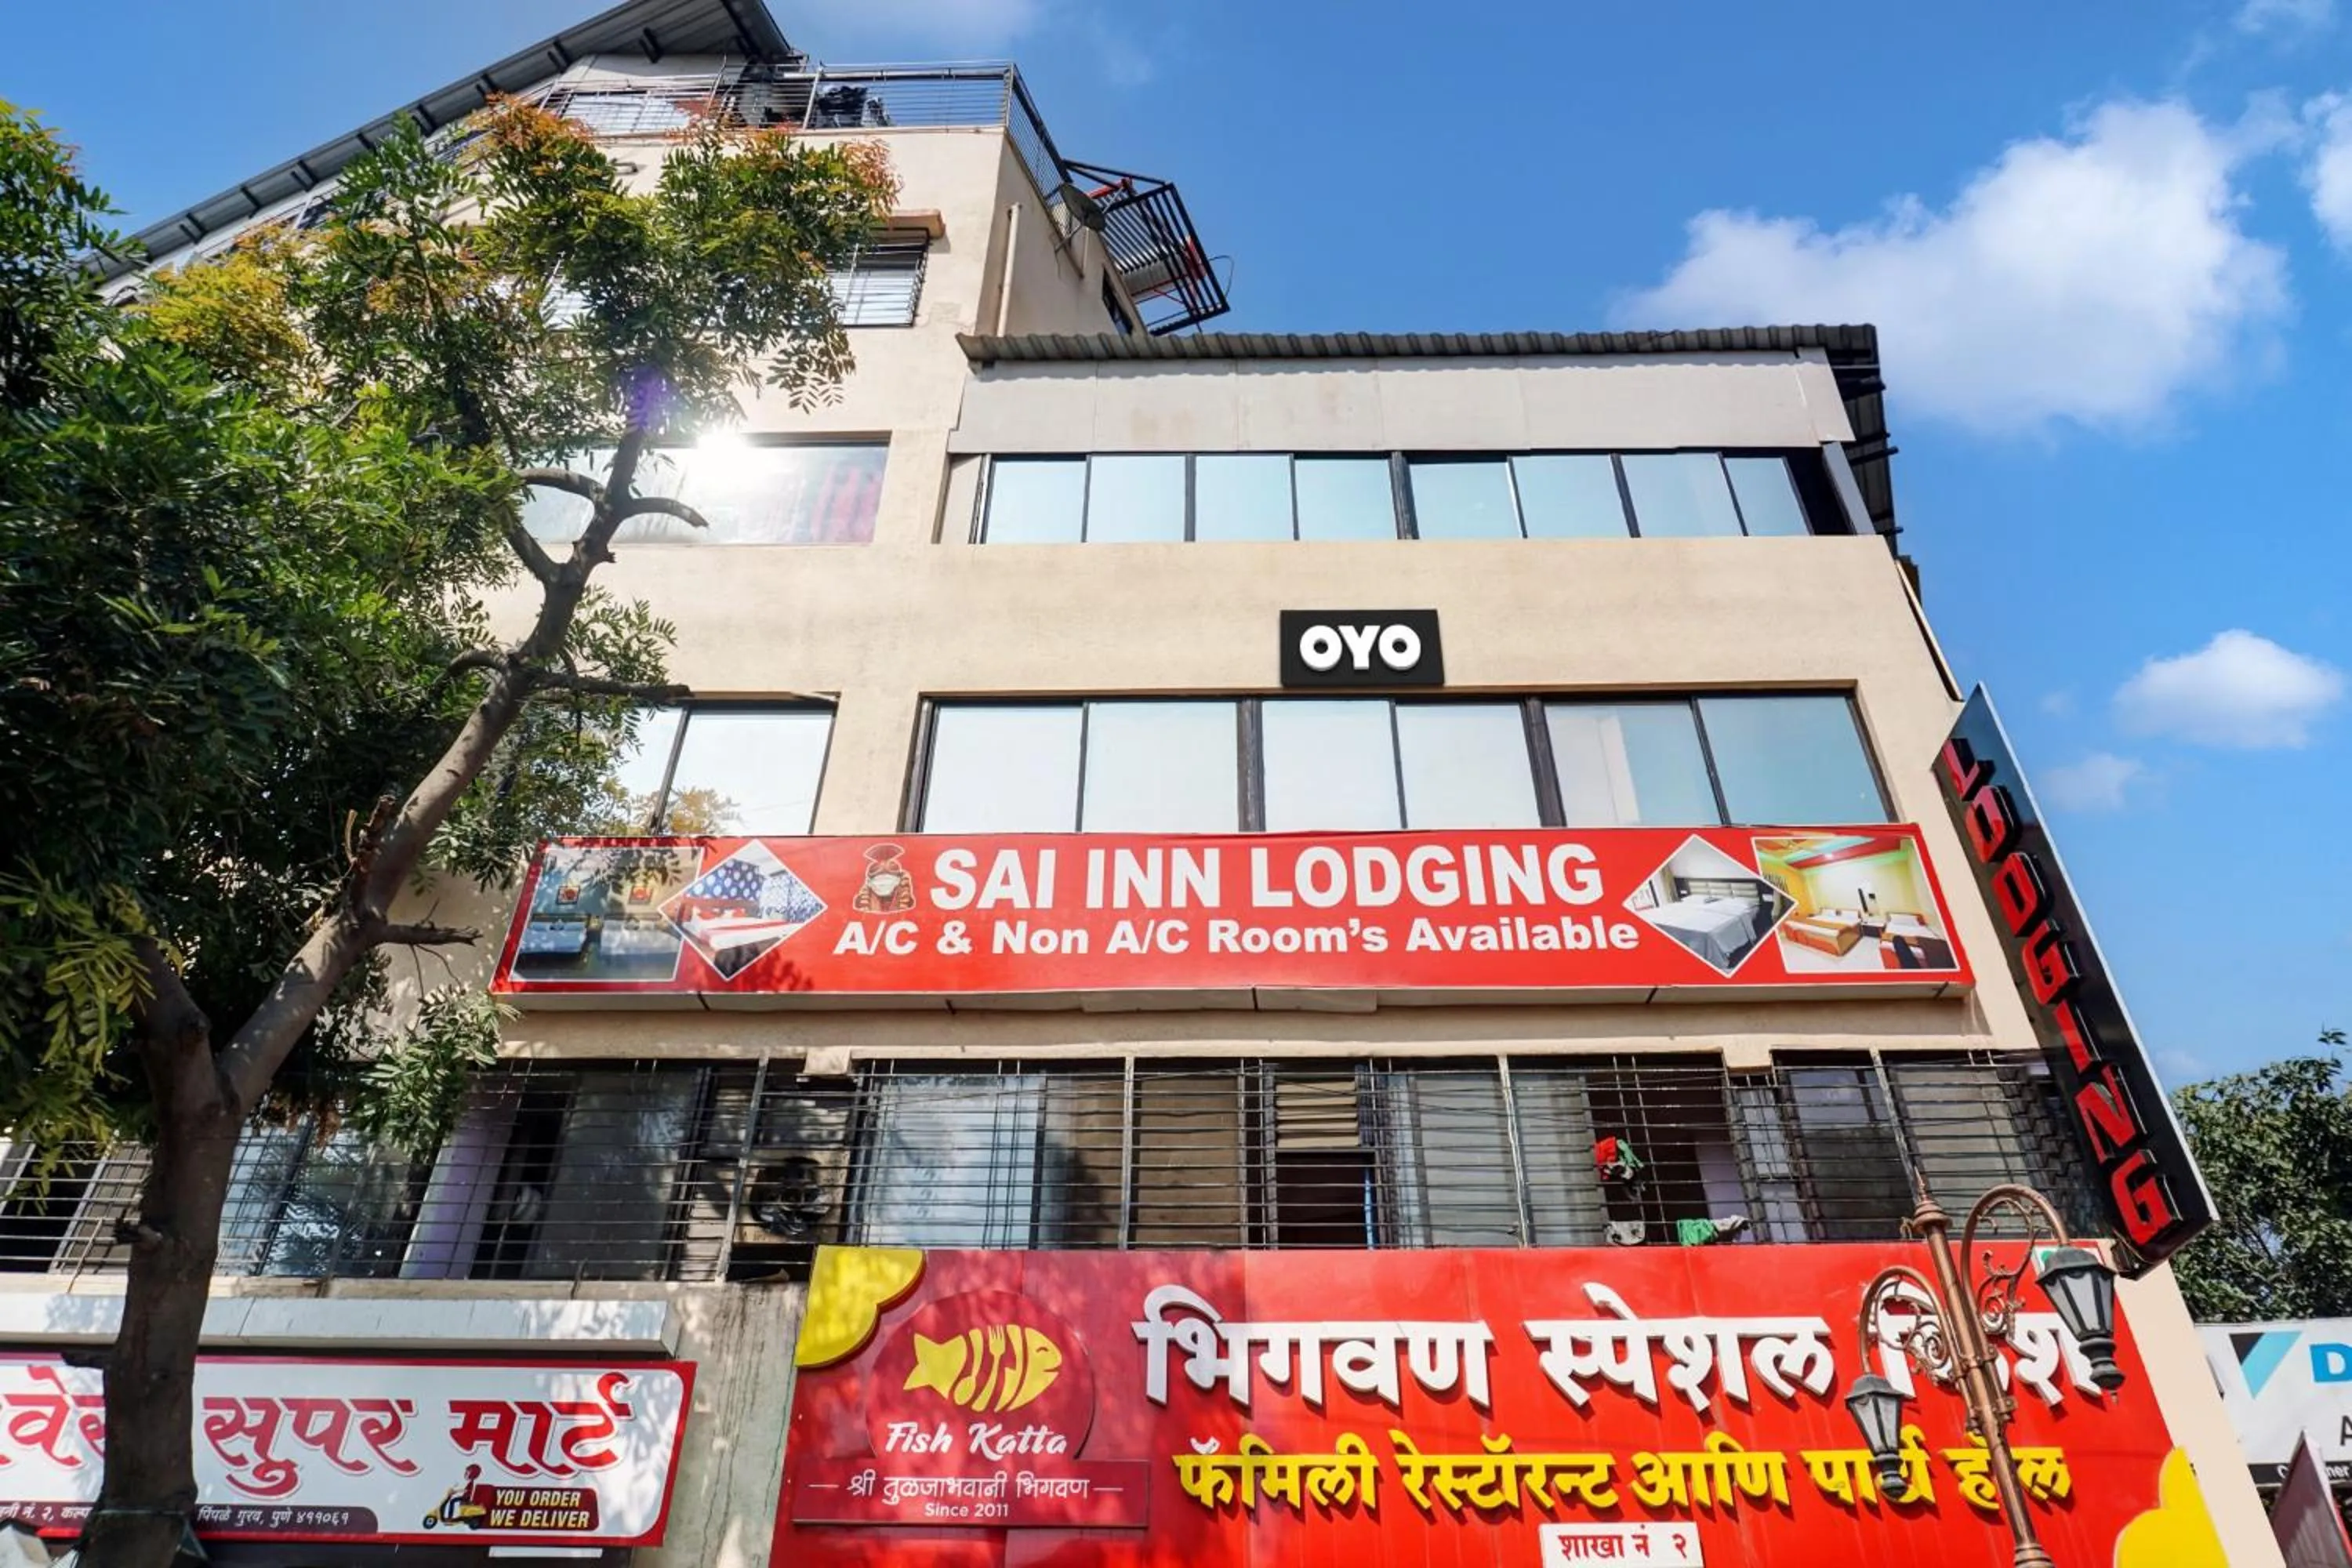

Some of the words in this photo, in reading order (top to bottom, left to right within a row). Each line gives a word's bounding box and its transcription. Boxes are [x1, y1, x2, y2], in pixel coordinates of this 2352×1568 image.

[1299, 623, 1421, 671] OYO
[930, 848, 1057, 910] SAI
[1086, 848, 1221, 909] INN
[1251, 844, 1605, 908] LODGING
[833, 920, 919, 955] A/C
[936, 920, 973, 955] &
[992, 920, 1089, 955] Non
[1105, 919, 1190, 954] A/C
[1405, 916, 1639, 951] Available
[1940, 738, 2183, 1247] LODGING
[1131, 1284, 1494, 1407] भिगवण
[1523, 1281, 1835, 1412] स्पेशल
[202, 1396, 419, 1498] सुपर
[448, 1371, 632, 1475] मार्ट
[885, 1421, 953, 1454] Fish
[968, 1421, 1068, 1461] Katta
[847, 1468, 877, 1497] श्री
[882, 1470, 1007, 1505] तुळजाभवानी
[1015, 1471, 1091, 1499] भिगवण
[1632, 1430, 1791, 1508] आणि
[489, 1509, 517, 1527] WE
[519, 1510, 590, 1528] DELIVER
[495, 1490, 527, 1507] YOU
[529, 1490, 581, 1508] ORDER
[925, 1502, 969, 1517] Since
[974, 1503, 1009, 1517] 2011
[1558, 1534, 1625, 1561] शाखा
[1671, 1532, 1688, 1559] २
